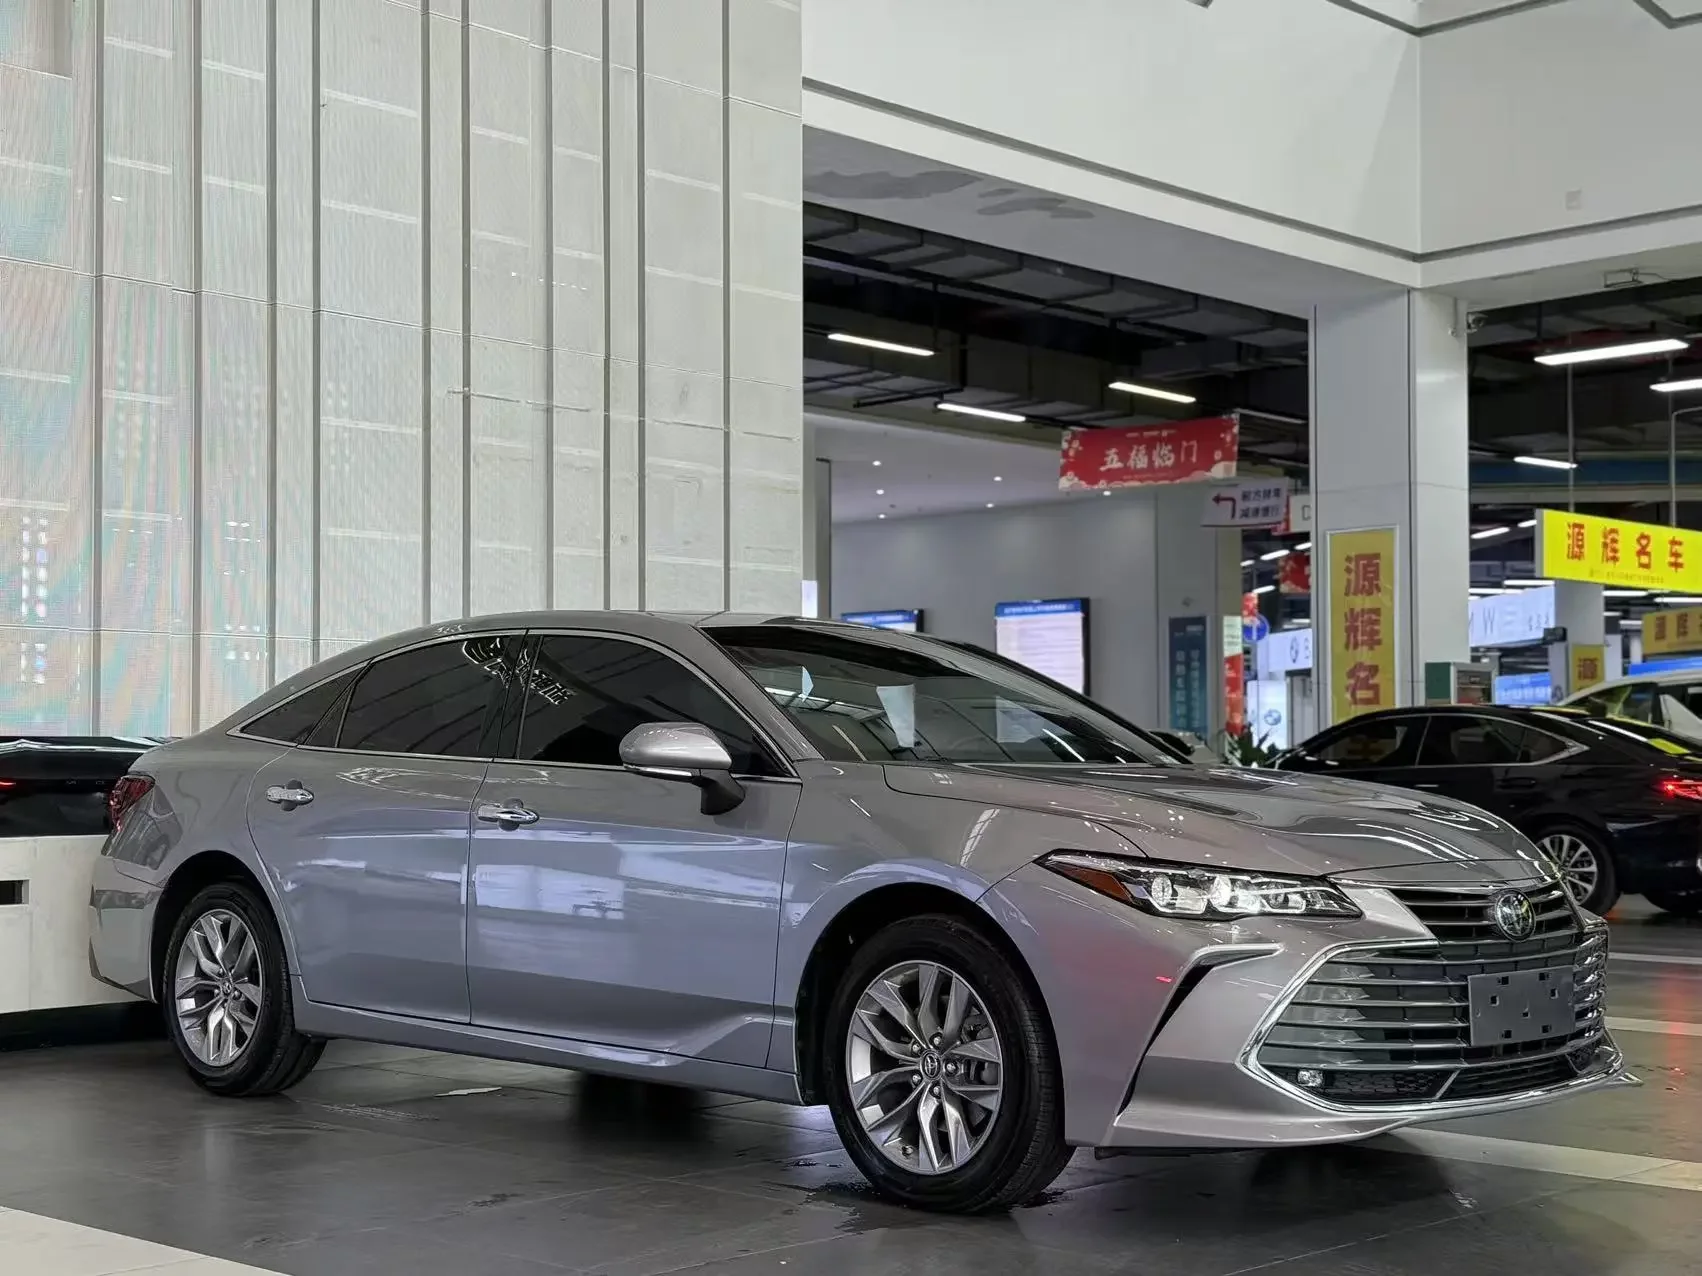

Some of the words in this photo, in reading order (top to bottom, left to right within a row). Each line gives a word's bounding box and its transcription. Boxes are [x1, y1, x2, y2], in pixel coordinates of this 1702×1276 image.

[1099, 440, 1197, 471] 五福临门
[1566, 521, 1684, 574] 源辉名车
[1344, 552, 1383, 706] 源辉名
